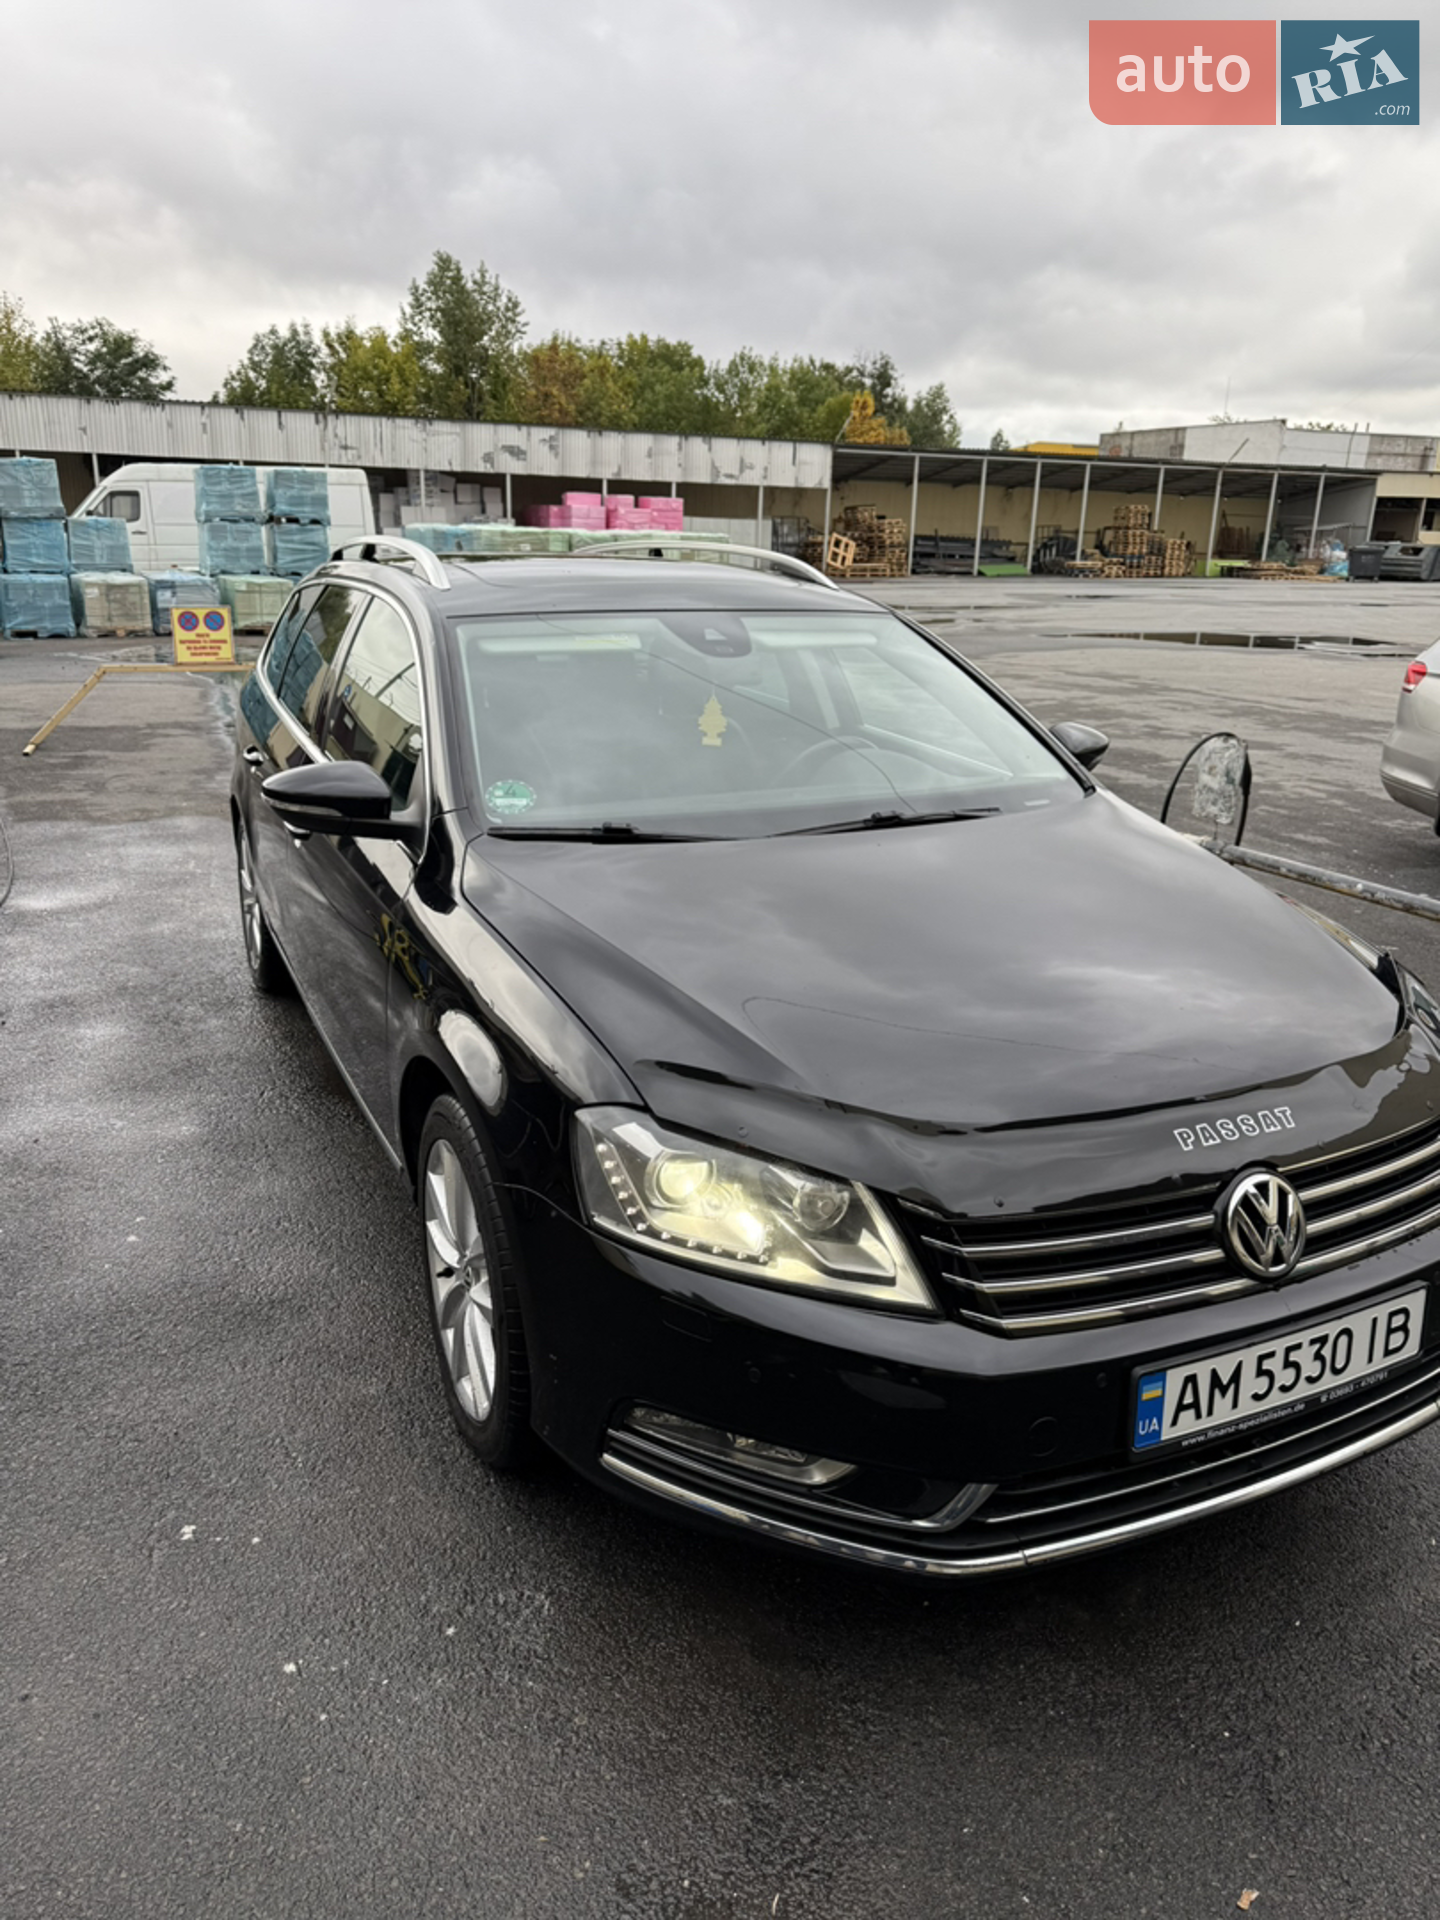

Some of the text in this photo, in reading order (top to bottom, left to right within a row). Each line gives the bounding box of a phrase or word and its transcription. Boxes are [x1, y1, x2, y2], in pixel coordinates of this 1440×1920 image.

[1173, 1106, 1296, 1151] PASSAT
[1170, 1306, 1411, 1428] AM 5530 IB
[1139, 1416, 1160, 1436] UA
